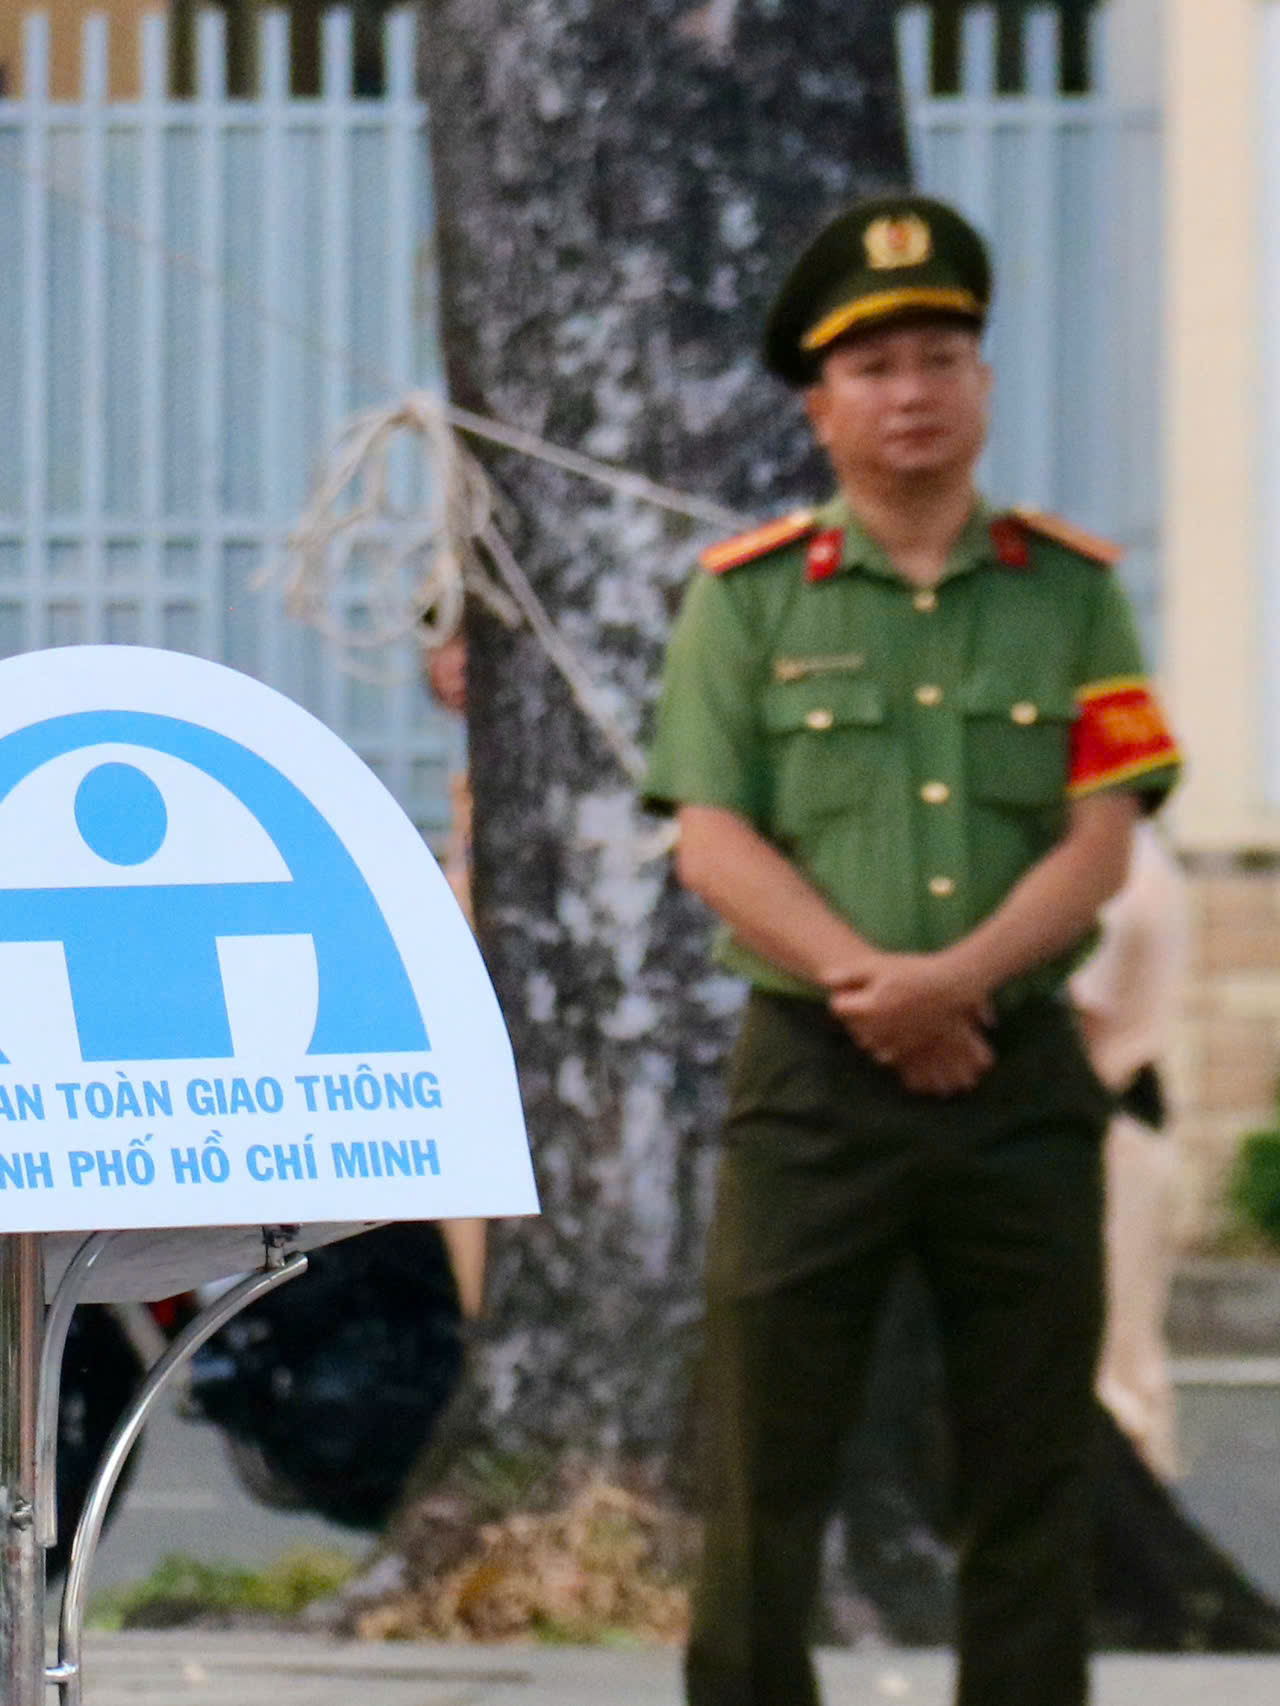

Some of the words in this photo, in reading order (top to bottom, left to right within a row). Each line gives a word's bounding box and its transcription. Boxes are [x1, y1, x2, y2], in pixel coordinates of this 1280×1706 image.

[56, 1072, 173, 1120] TOÀN
[187, 1077, 284, 1116] GIAO
[296, 1064, 443, 1112] THÔNG
[69, 1134, 155, 1188] PHỐ
[170, 1130, 230, 1184] HỒ
[247, 1134, 317, 1182] CHÍ
[331, 1139, 440, 1178] MINH
